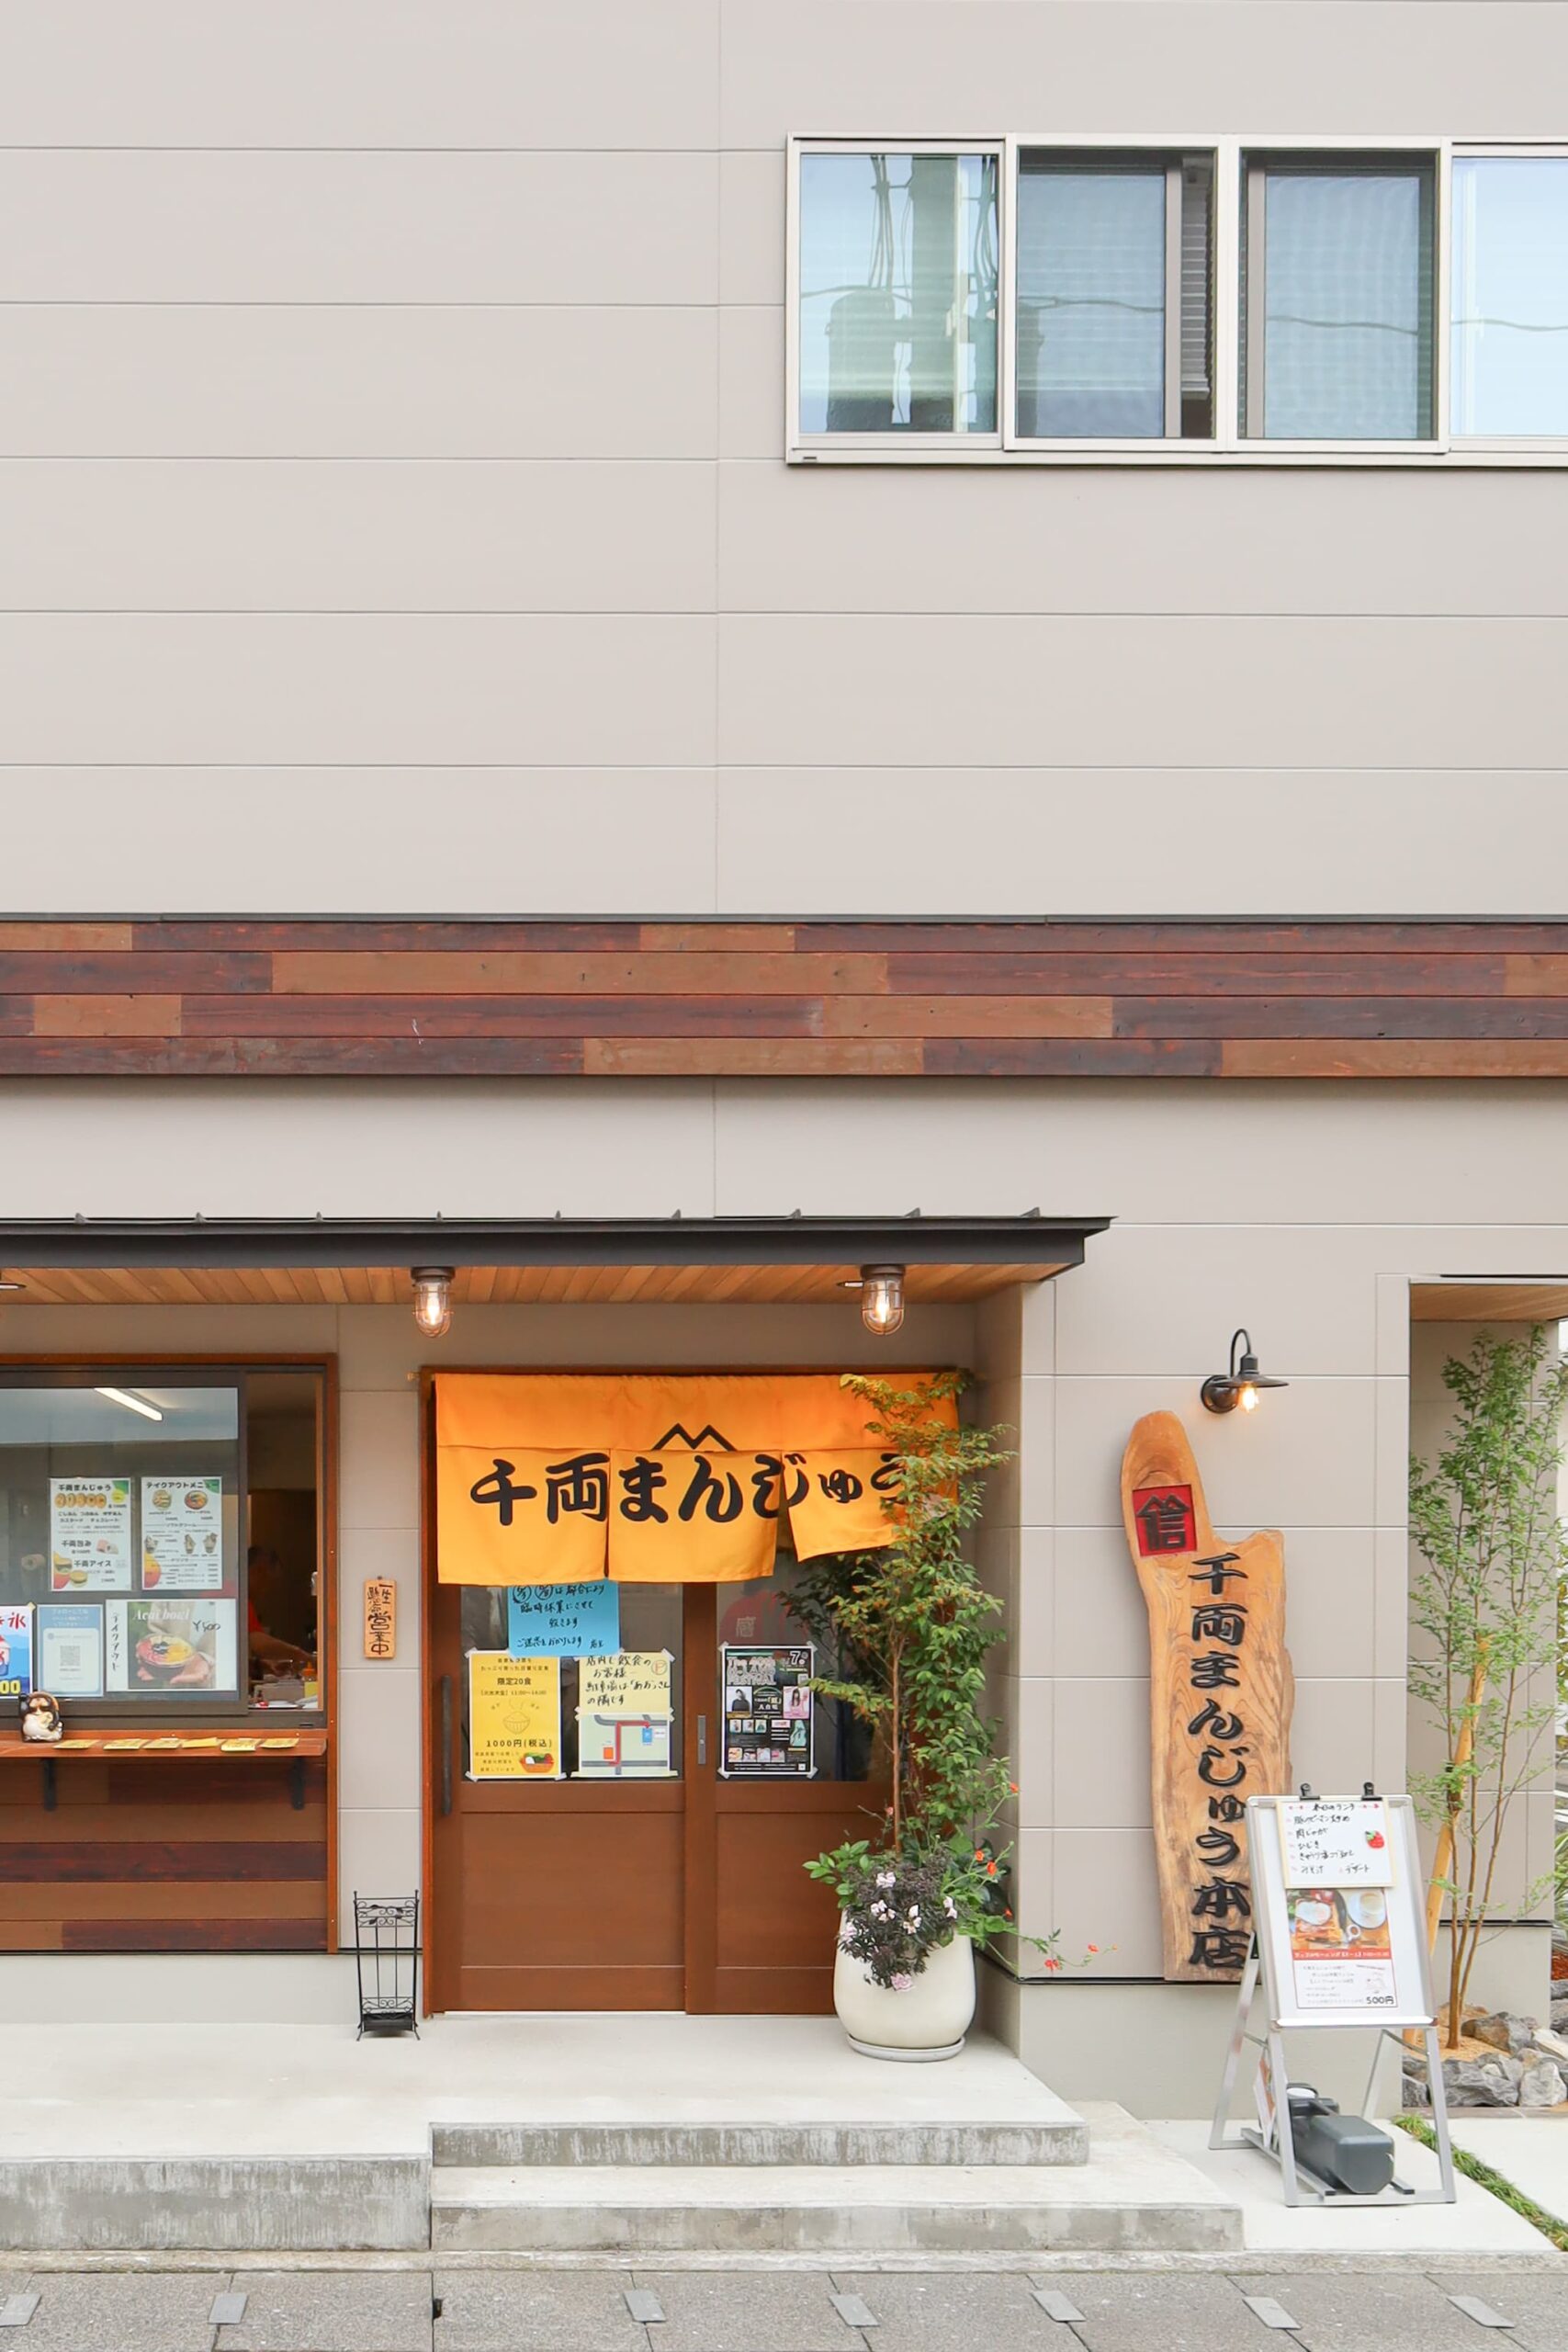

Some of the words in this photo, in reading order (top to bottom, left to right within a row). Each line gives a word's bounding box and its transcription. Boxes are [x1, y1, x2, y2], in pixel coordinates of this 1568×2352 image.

[0, 1611, 26, 1629] 氷
[497, 1678, 532, 1686] 限定20食
[1188, 1551, 1252, 1971] 千両まんじゅう本店
[1366, 1996, 1394, 2005] 500円
